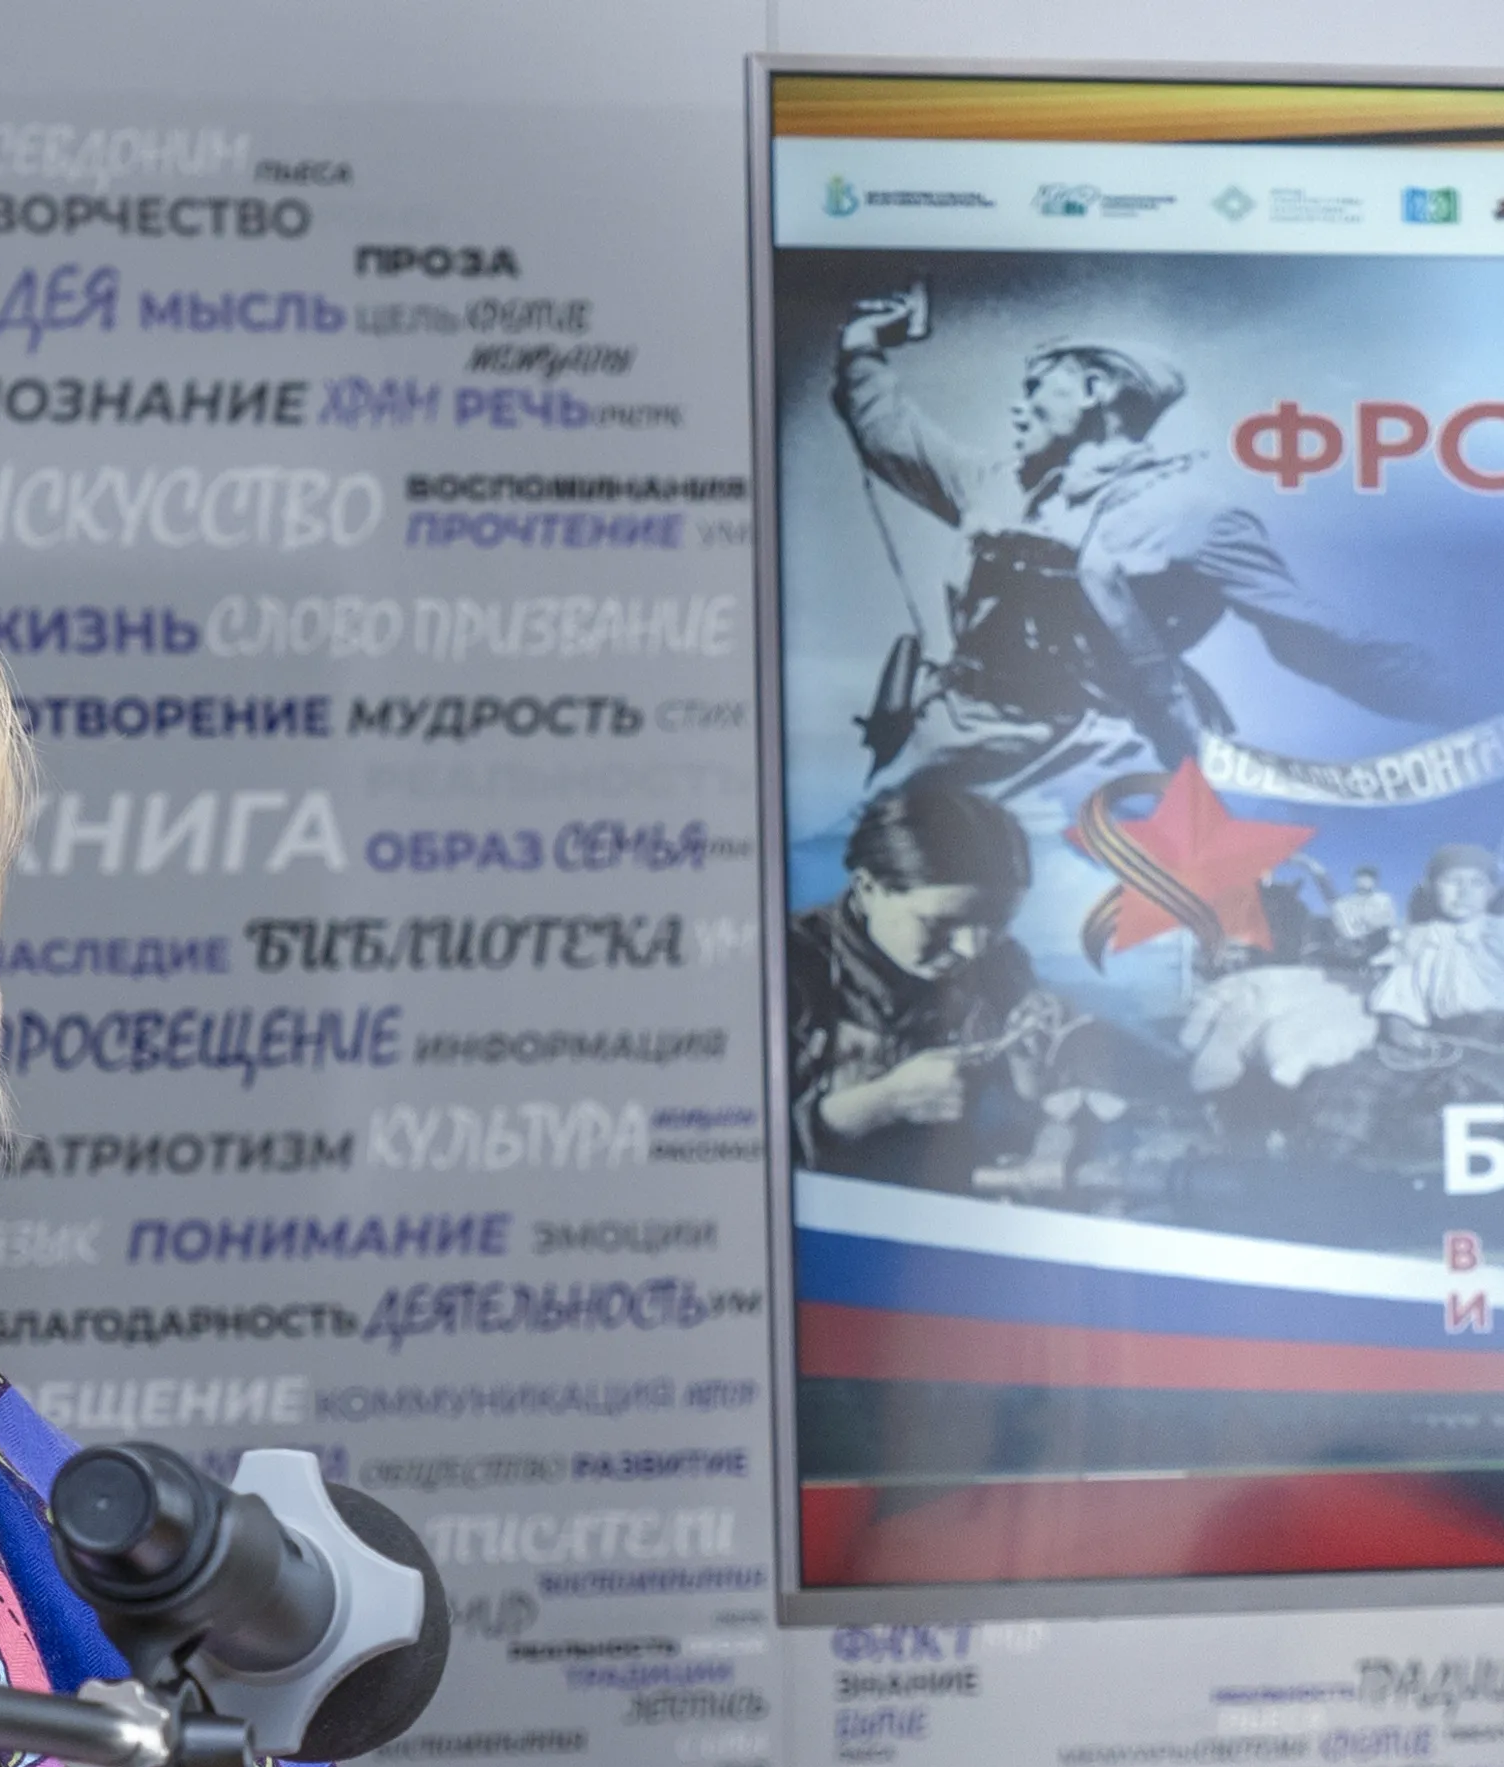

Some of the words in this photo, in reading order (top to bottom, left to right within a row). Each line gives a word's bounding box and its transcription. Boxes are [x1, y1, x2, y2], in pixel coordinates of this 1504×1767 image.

[354, 245, 520, 279] ПРОЗА
[138, 291, 347, 333] МЫСЛЬ
[454, 385, 588, 429] РЕЧЬ
[405, 510, 685, 550] ПРОЧТЕНИЕ
[204, 593, 405, 658] СЛОВО
[414, 594, 739, 661] ПРИЗВАНИЕ
[346, 694, 646, 744] МУДРОСТЬ
[365, 829, 544, 873] ОБРАЗ
[244, 912, 686, 972] БИБЛИОТЕКА
[413, 1027, 729, 1066] ИНФОРМАЦИЯ
[368, 1100, 649, 1171] КУЛЬТУРА
[127, 1211, 513, 1265] ПОНИМАНИЕ
[530, 1219, 718, 1257] ЭМОЦИИ
[1445, 1230, 1482, 1274] В
[1445, 1290, 1492, 1333] И
[571, 1444, 750, 1483] РАЗВИТИЕ
